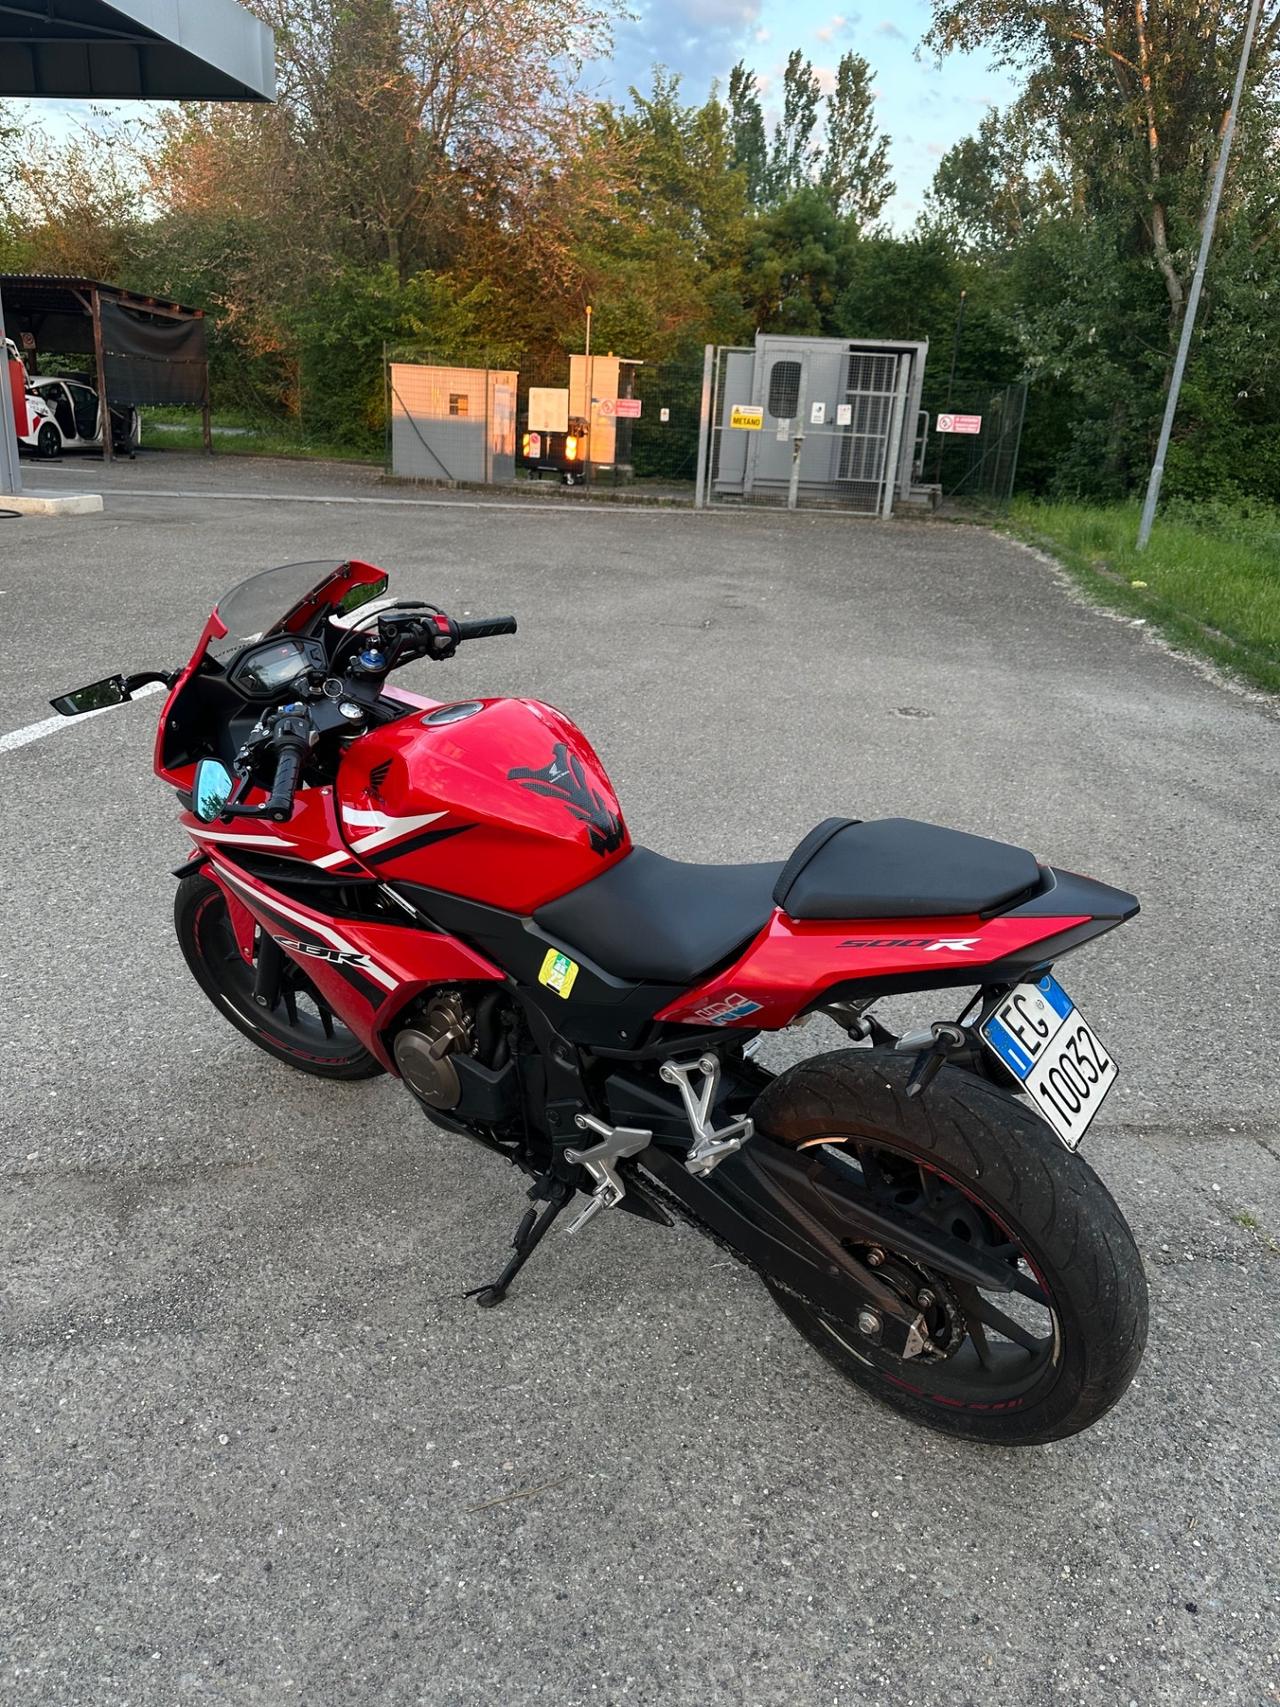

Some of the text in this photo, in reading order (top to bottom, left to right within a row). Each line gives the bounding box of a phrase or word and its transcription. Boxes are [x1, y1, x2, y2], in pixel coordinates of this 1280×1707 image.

[733, 417, 760, 426] METANO
[272, 934, 371, 968] CBR
[1000, 994, 1049, 1056] EG
[1040, 1025, 1109, 1127] 10032
